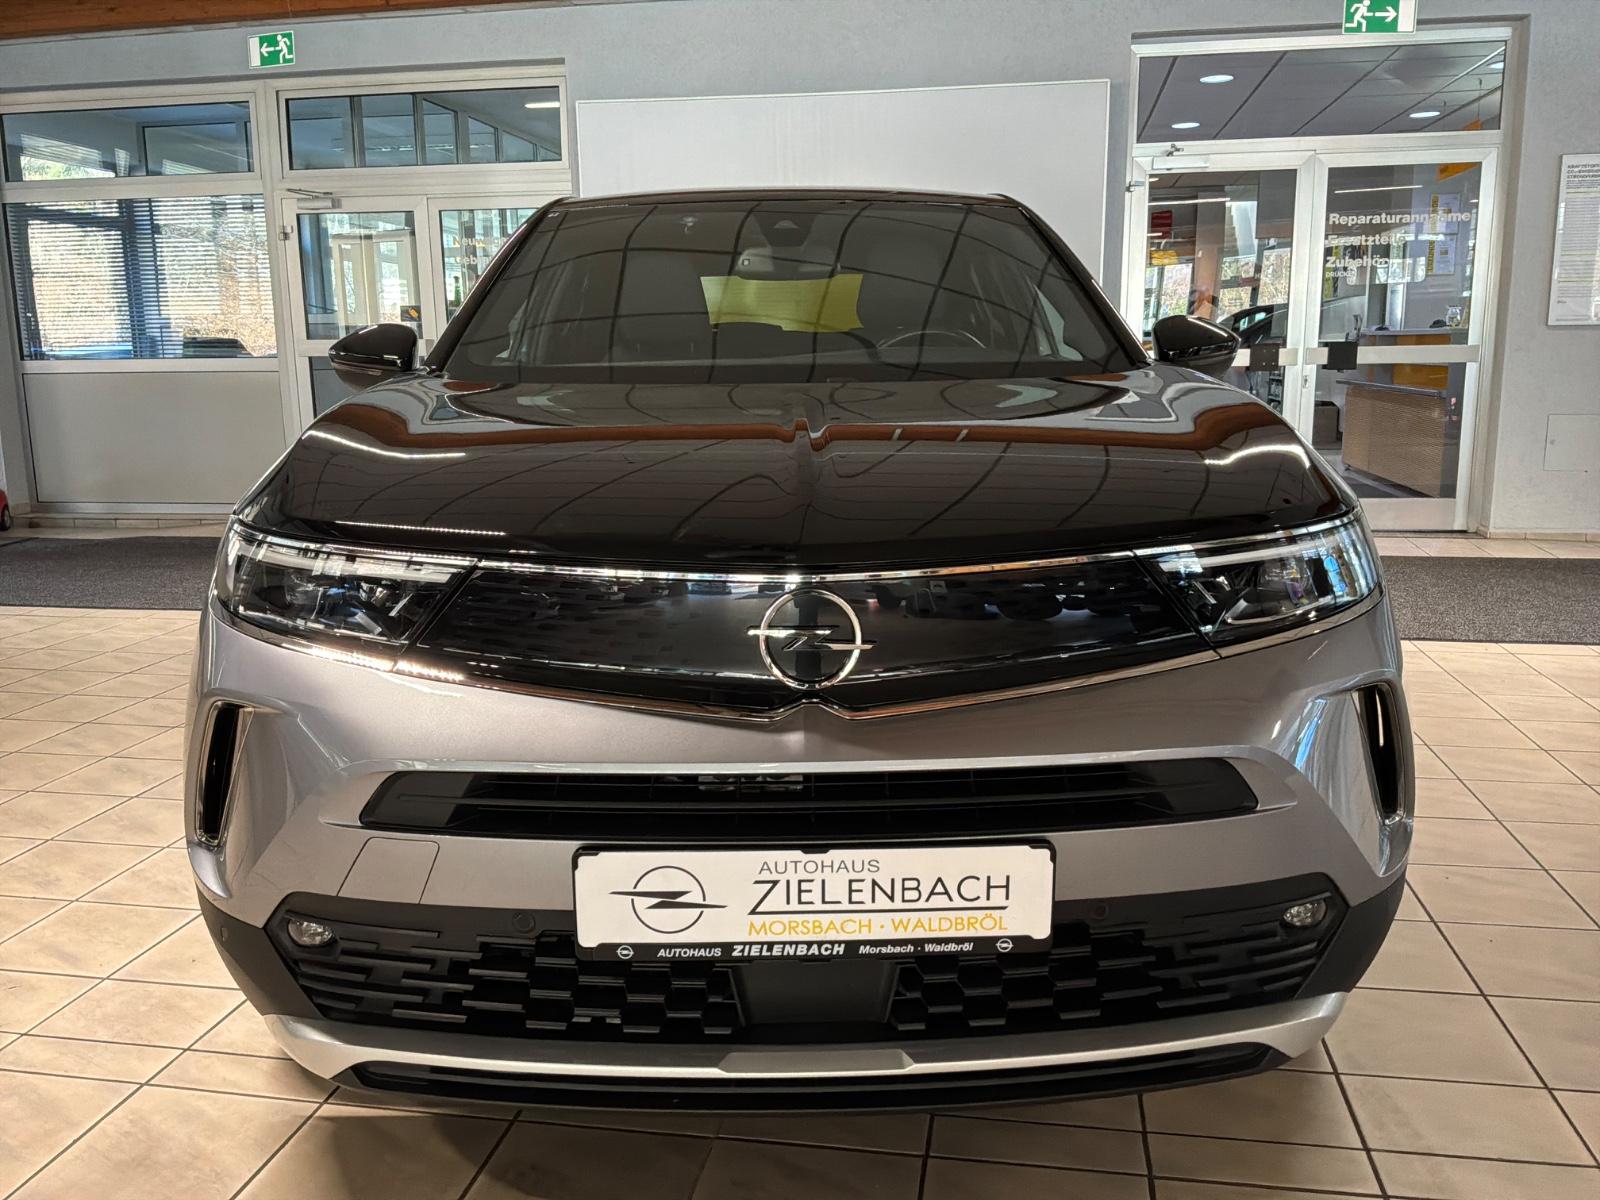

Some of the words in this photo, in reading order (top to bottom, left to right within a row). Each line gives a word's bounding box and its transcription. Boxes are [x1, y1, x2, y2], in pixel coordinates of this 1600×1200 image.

[758, 858, 880, 874] AUTOHAUS
[748, 874, 1010, 915] ZIELENBACH
[748, 918, 872, 936] MORSBACH
[890, 912, 1009, 933] WALDBRÖL
[657, 947, 722, 958] AUTOHAUS
[731, 943, 845, 957] ZIELENBACH
[858, 944, 914, 955] Morsbach
[924, 942, 974, 953] Waldbröl
